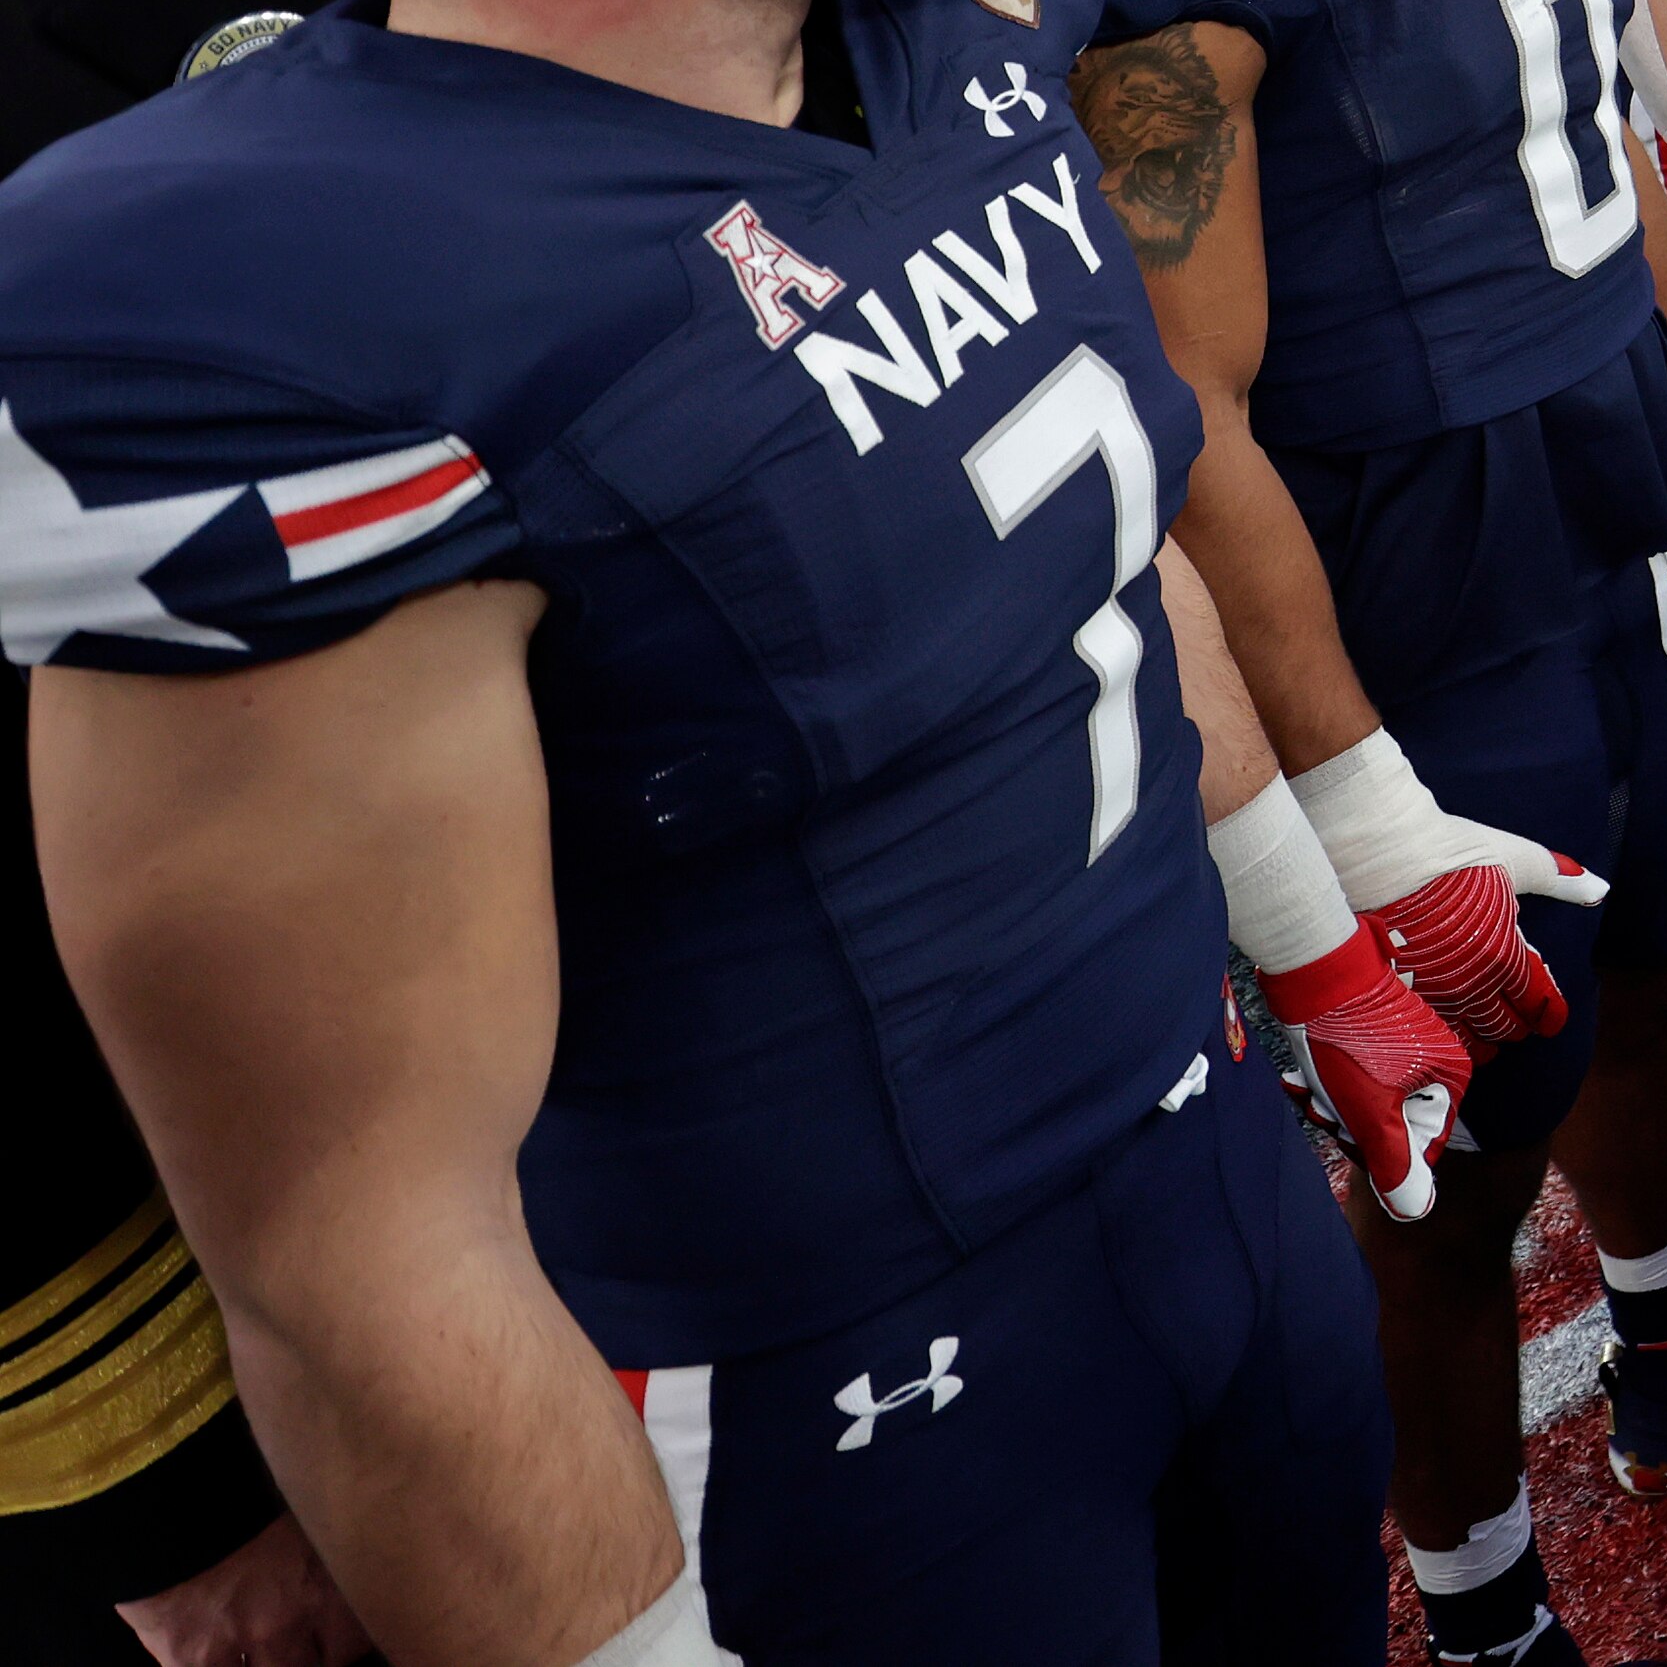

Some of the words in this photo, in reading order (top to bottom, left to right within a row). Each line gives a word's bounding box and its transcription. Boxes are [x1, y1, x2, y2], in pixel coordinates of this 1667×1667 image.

[208, 34, 235, 56] GO
[236, 18, 292, 39] NAVY
[794, 153, 1103, 457] NAVY
[960, 343, 1159, 869] 7
